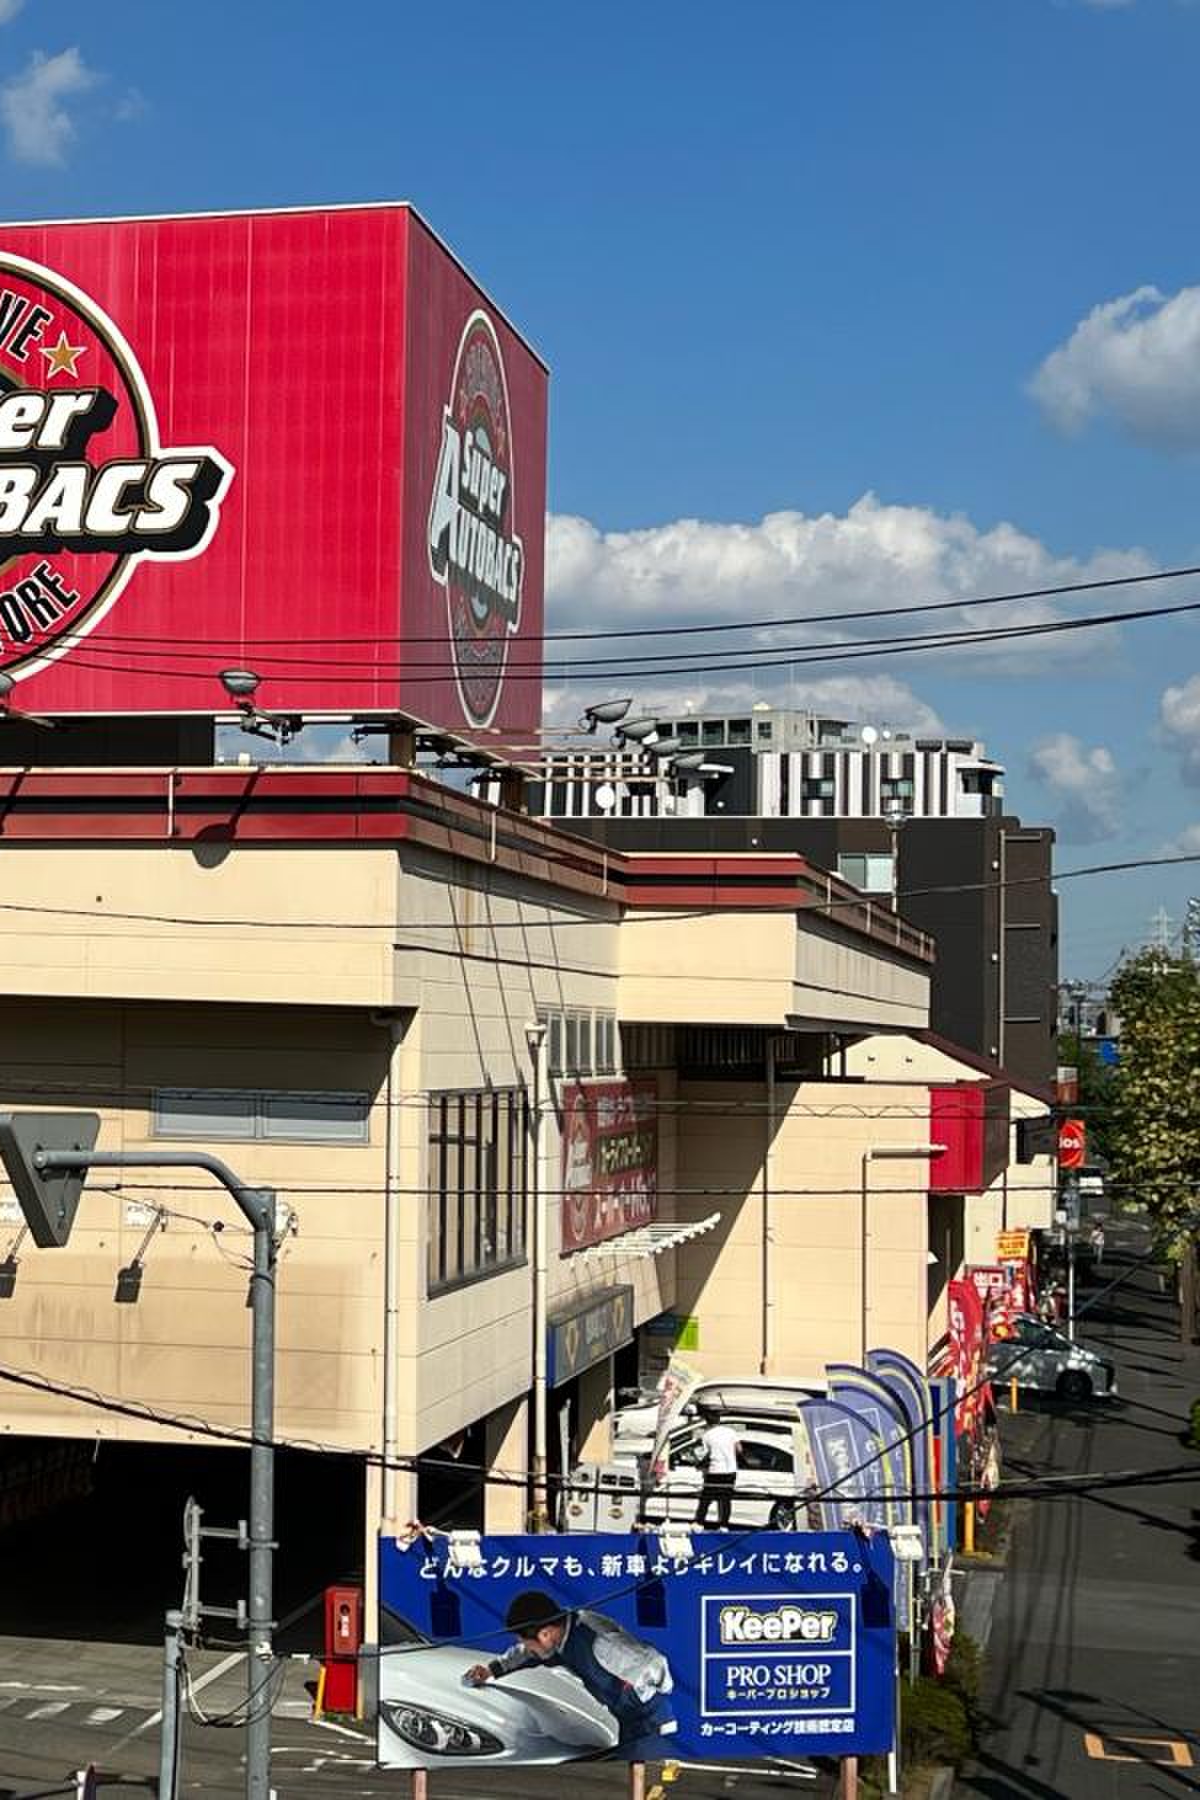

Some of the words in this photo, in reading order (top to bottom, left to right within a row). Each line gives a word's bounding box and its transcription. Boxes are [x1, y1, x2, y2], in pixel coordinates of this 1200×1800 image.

[461, 429, 508, 520] Super
[431, 423, 522, 604] AUTOBACS
[720, 1606, 837, 1644] KeePer
[726, 1664, 771, 1687] PRO
[773, 1664, 832, 1686] SHOP
